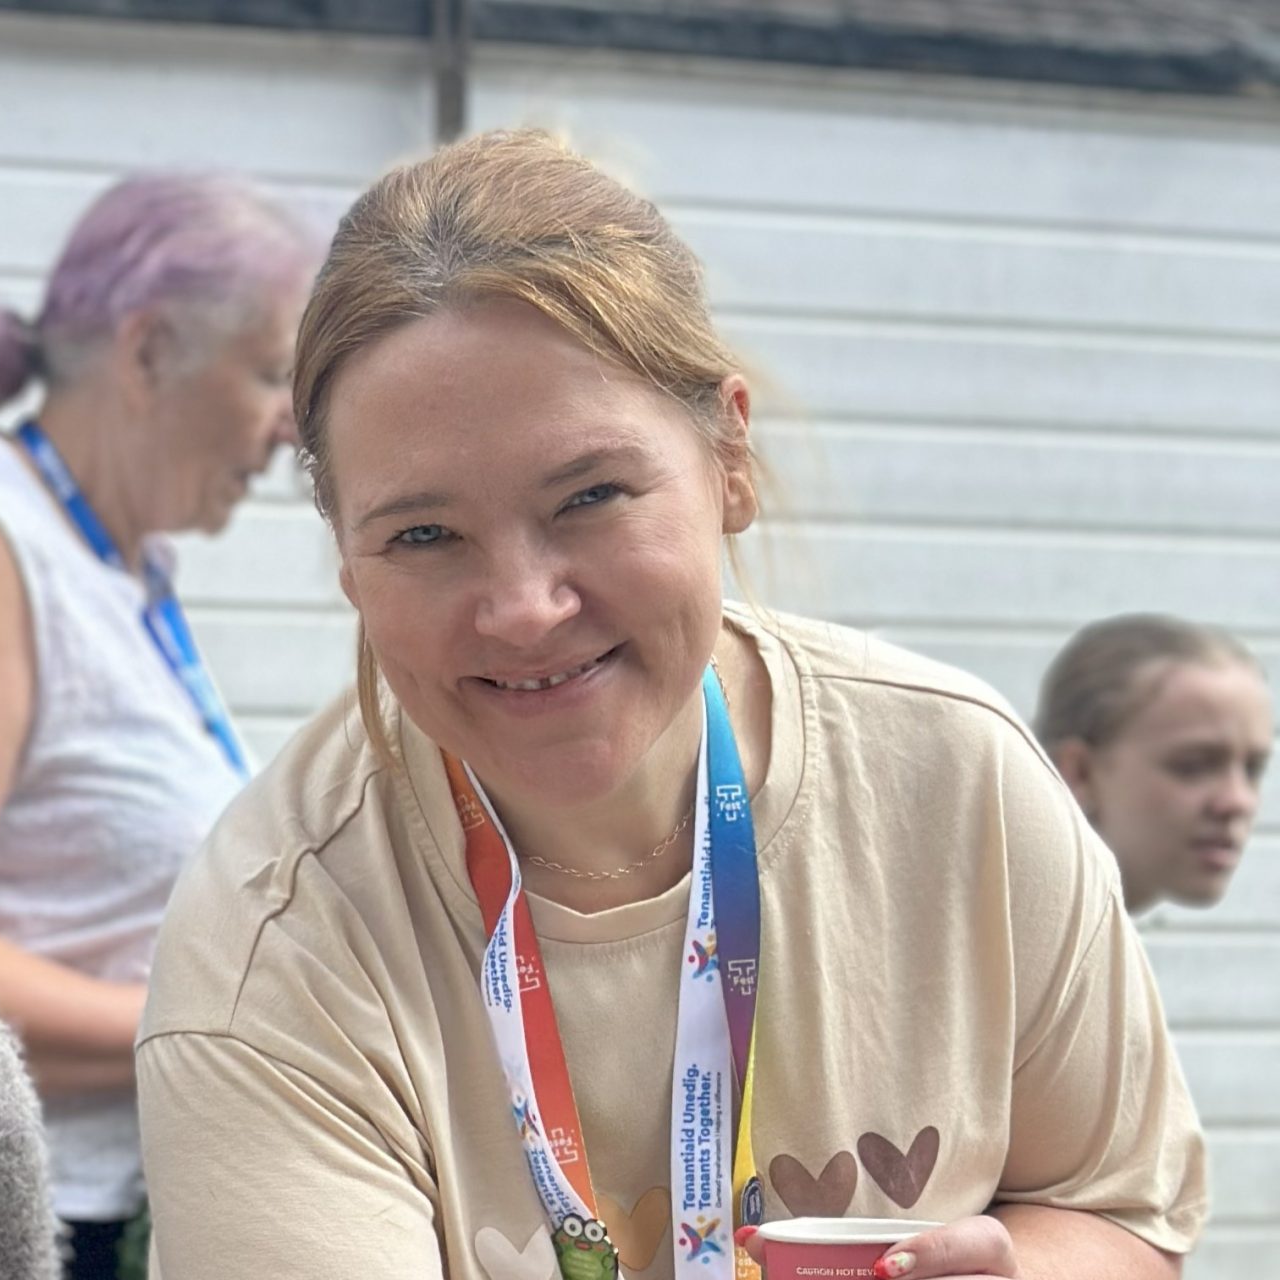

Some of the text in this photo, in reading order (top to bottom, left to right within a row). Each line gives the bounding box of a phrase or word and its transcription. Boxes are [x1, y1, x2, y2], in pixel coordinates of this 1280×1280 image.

[681, 1064, 699, 1211] Tenantiaid Unedig.
[697, 1071, 714, 1210] Tenants Together.
[796, 1266, 834, 1276] CAUTION
